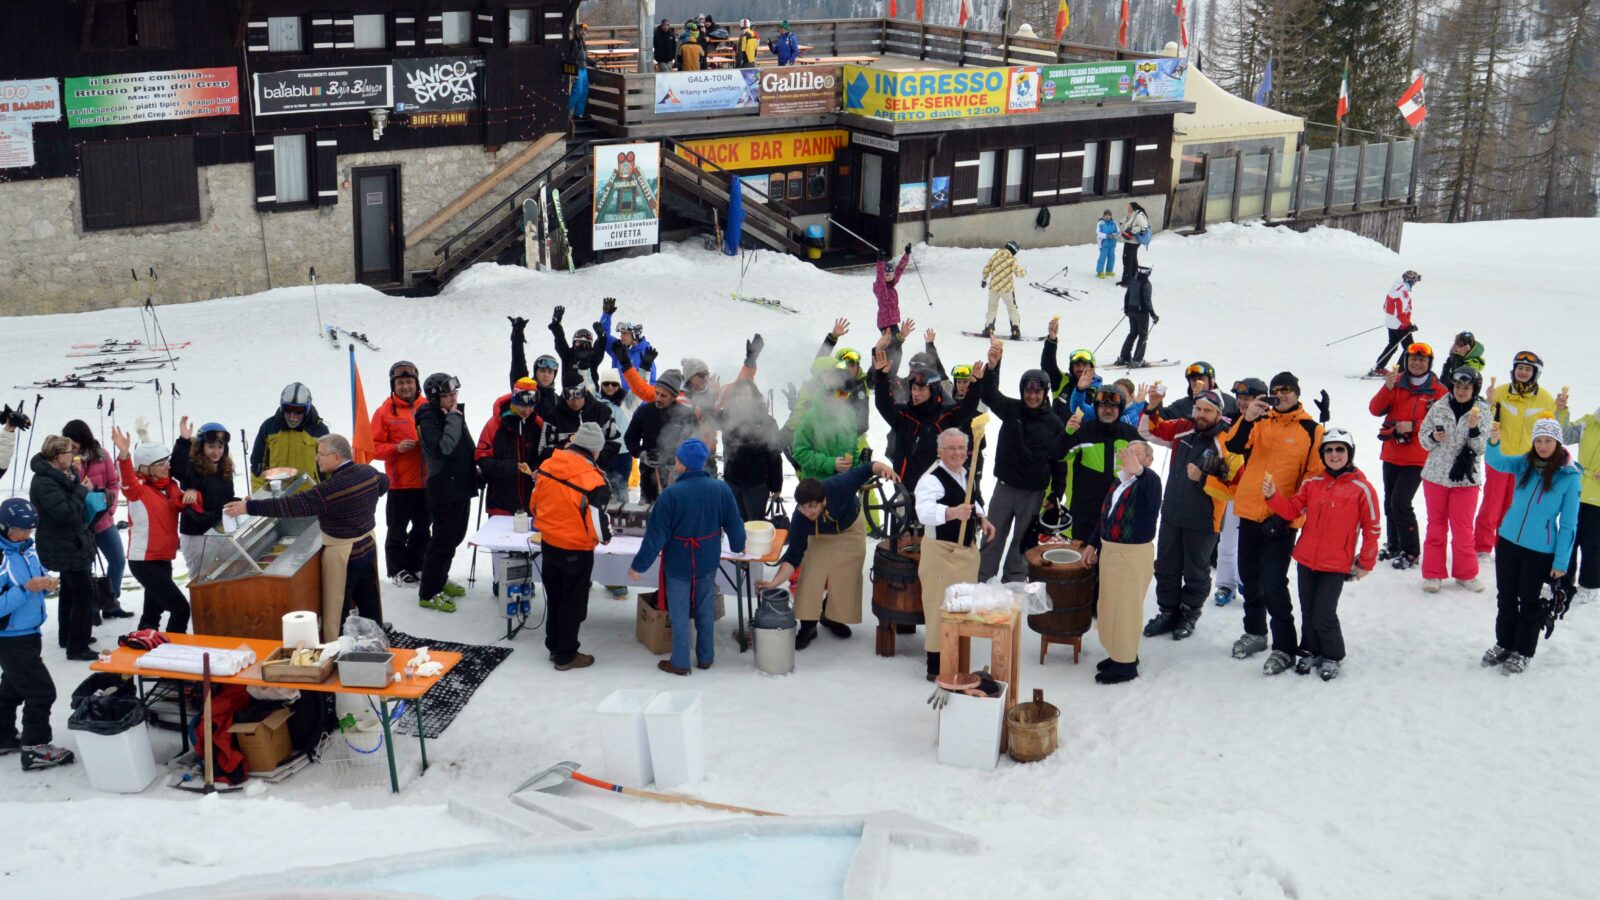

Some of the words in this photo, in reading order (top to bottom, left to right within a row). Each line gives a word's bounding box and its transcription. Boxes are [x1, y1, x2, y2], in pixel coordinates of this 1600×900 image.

[89, 78, 98, 86] il
[102, 75, 146, 86] Barone
[687, 74, 733, 83] GALA-TOUR
[762, 71, 834, 93] Gallileo
[875, 71, 1003, 97] INGRESSO
[75, 87, 128, 97] Rifugio
[133, 84, 165, 93] Pian
[170, 81, 192, 90] dei
[196, 80, 230, 89] Crep
[326, 81, 350, 98] Baja
[153, 92, 177, 100] Bepi
[884, 94, 988, 111] SELF-SERVICE
[12, 100, 55, 112] BAMBINI
[96, 105, 128, 114] speciali
[136, 102, 157, 111] piatti
[159, 100, 180, 109] tipici
[188, 98, 214, 107] grappe
[874, 108, 925, 120] APERTO
[930, 107, 962, 118] dalle
[966, 106, 1000, 115] 12:00
[113, 113, 131, 121] Pian
[133, 111, 146, 120] dei
[149, 110, 166, 119] Crep
[174, 108, 195, 117] Zoldo
[198, 107, 214, 115] Alto
[412, 114, 438, 125] BIBITE
[441, 113, 466, 123] PANINI
[684, 141, 740, 165] SNACK
[751, 139, 783, 161] BAR
[793, 135, 844, 158] PANINI
[629, 220, 657, 228] Snowboard
[610, 228, 642, 239] CIVETTA
